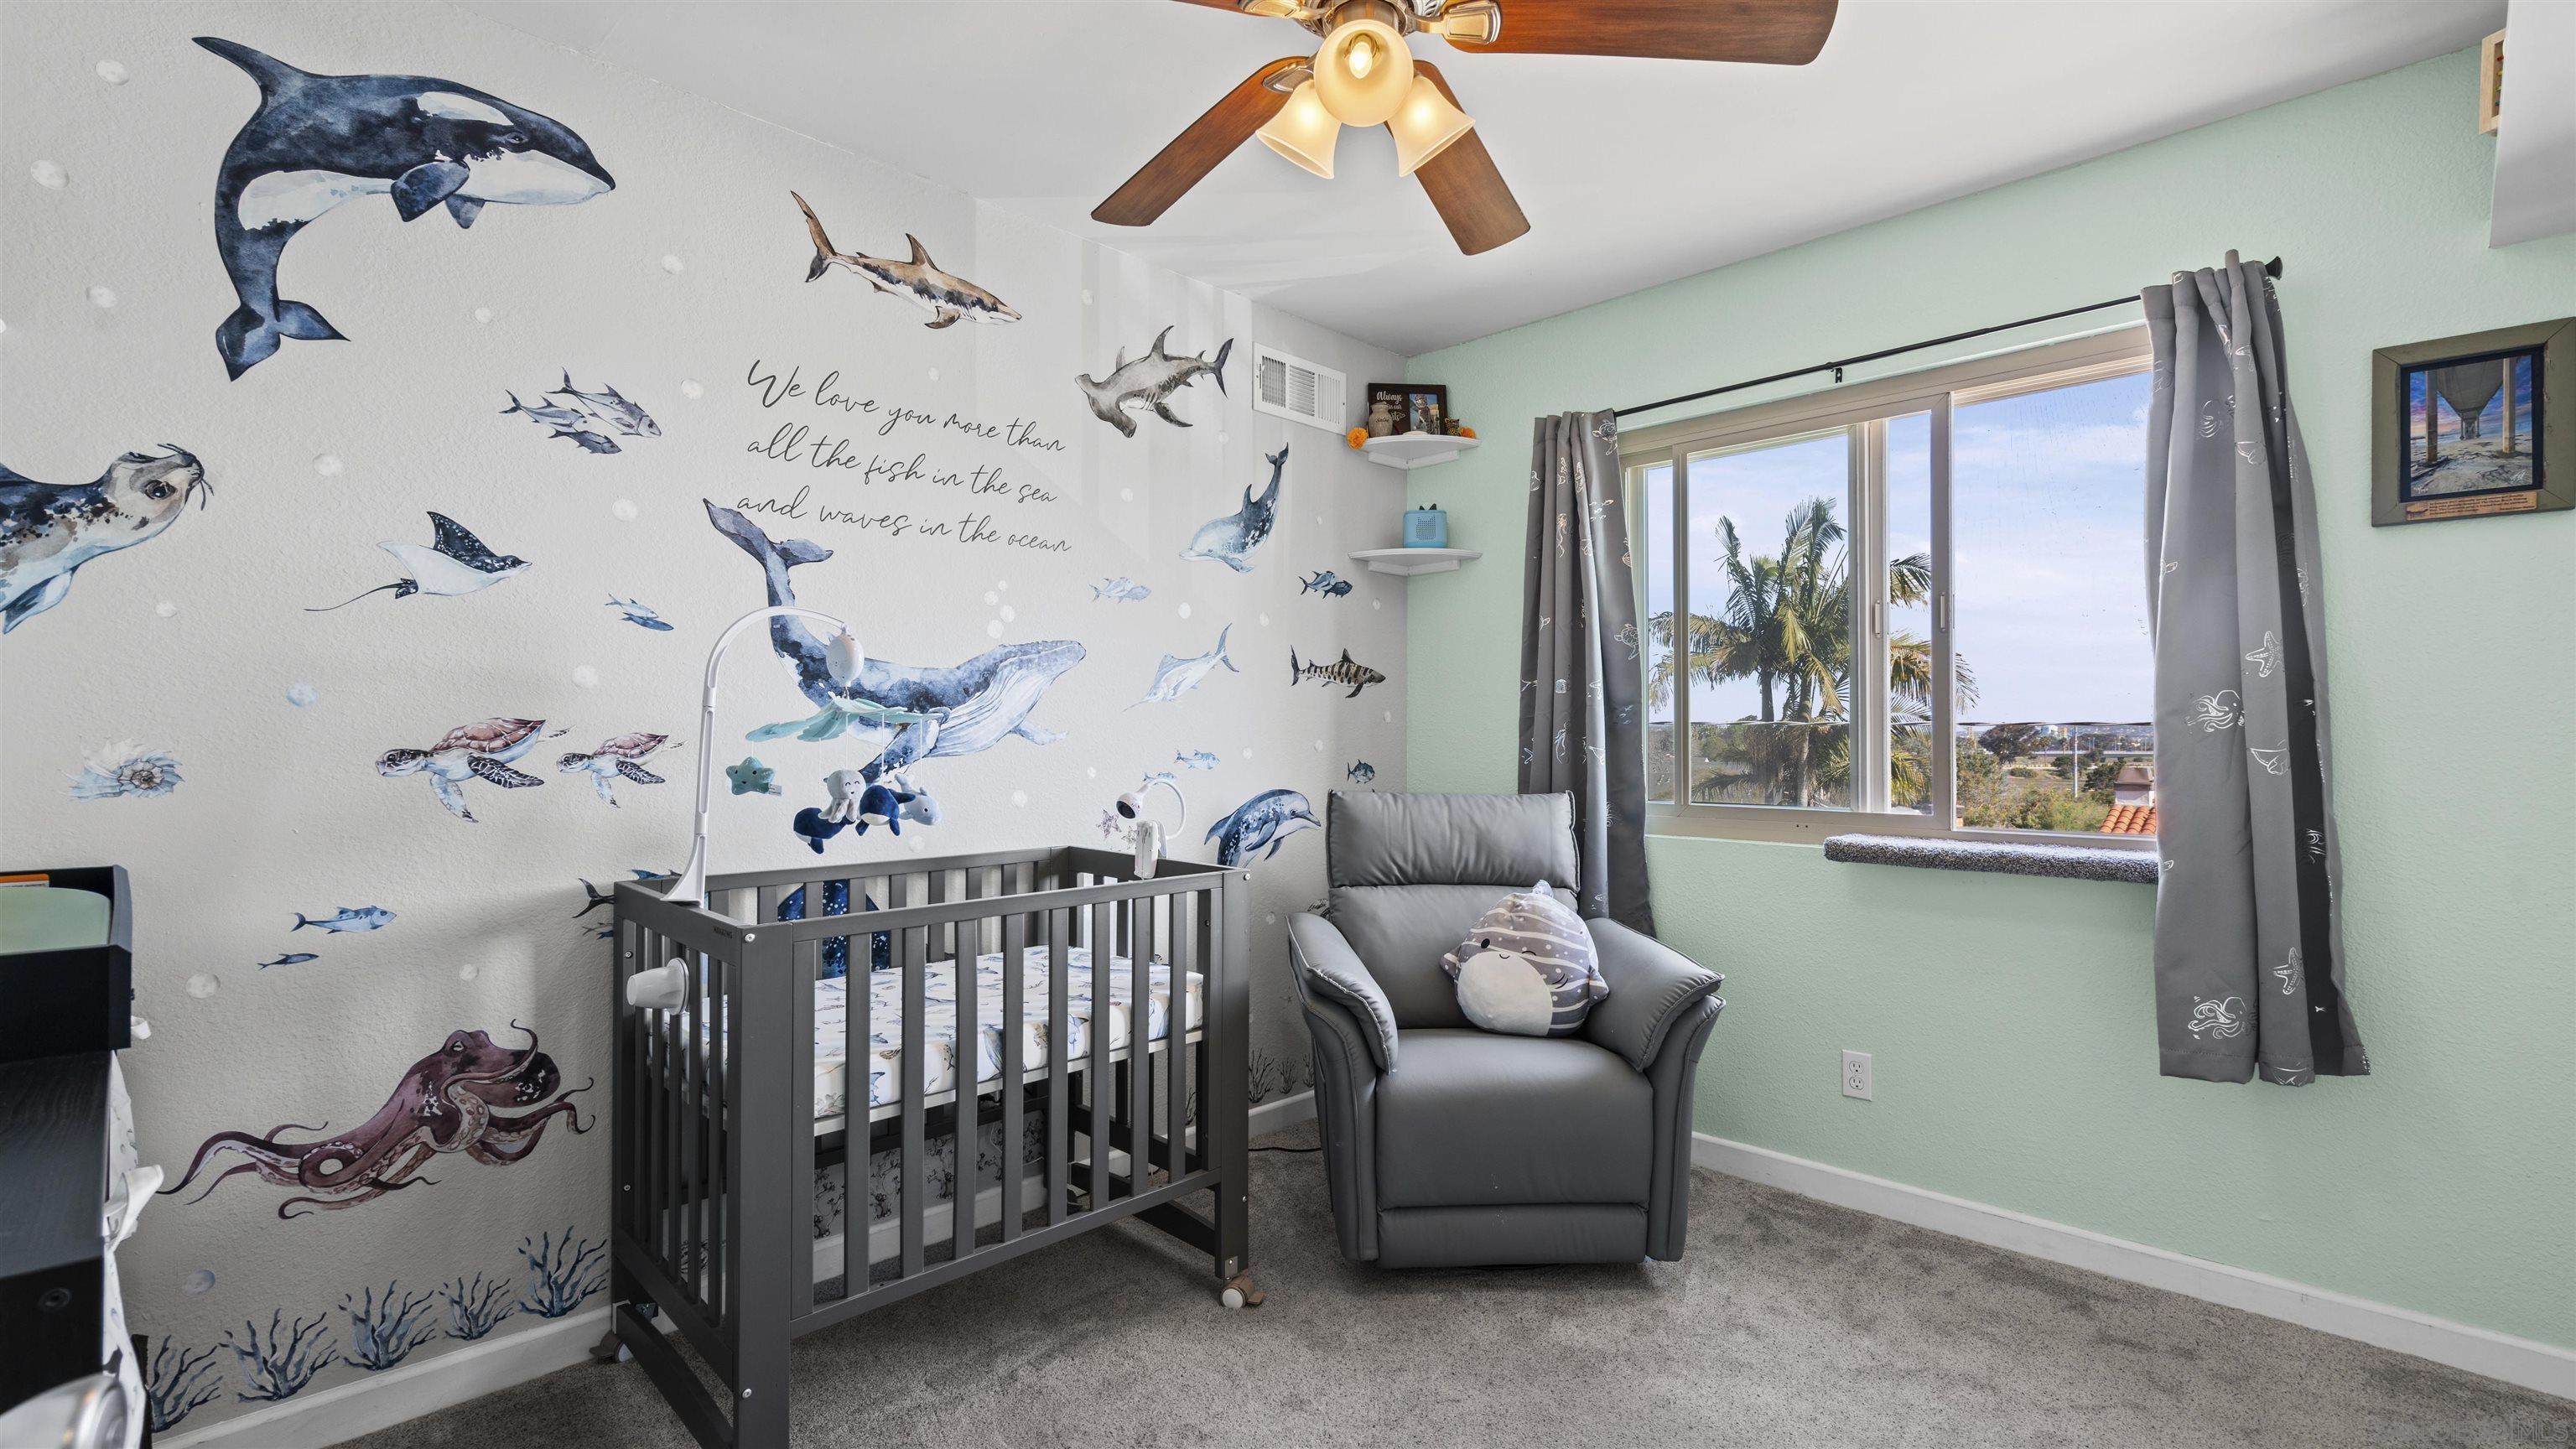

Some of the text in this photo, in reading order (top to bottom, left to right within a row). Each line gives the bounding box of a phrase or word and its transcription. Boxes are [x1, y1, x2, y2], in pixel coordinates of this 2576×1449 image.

[748, 360, 1066, 451] We love you more than
[1376, 391, 1403, 404] Always
[747, 423, 1057, 503] all the fish in the sea
[736, 486, 1072, 552] and waves in the ocean
